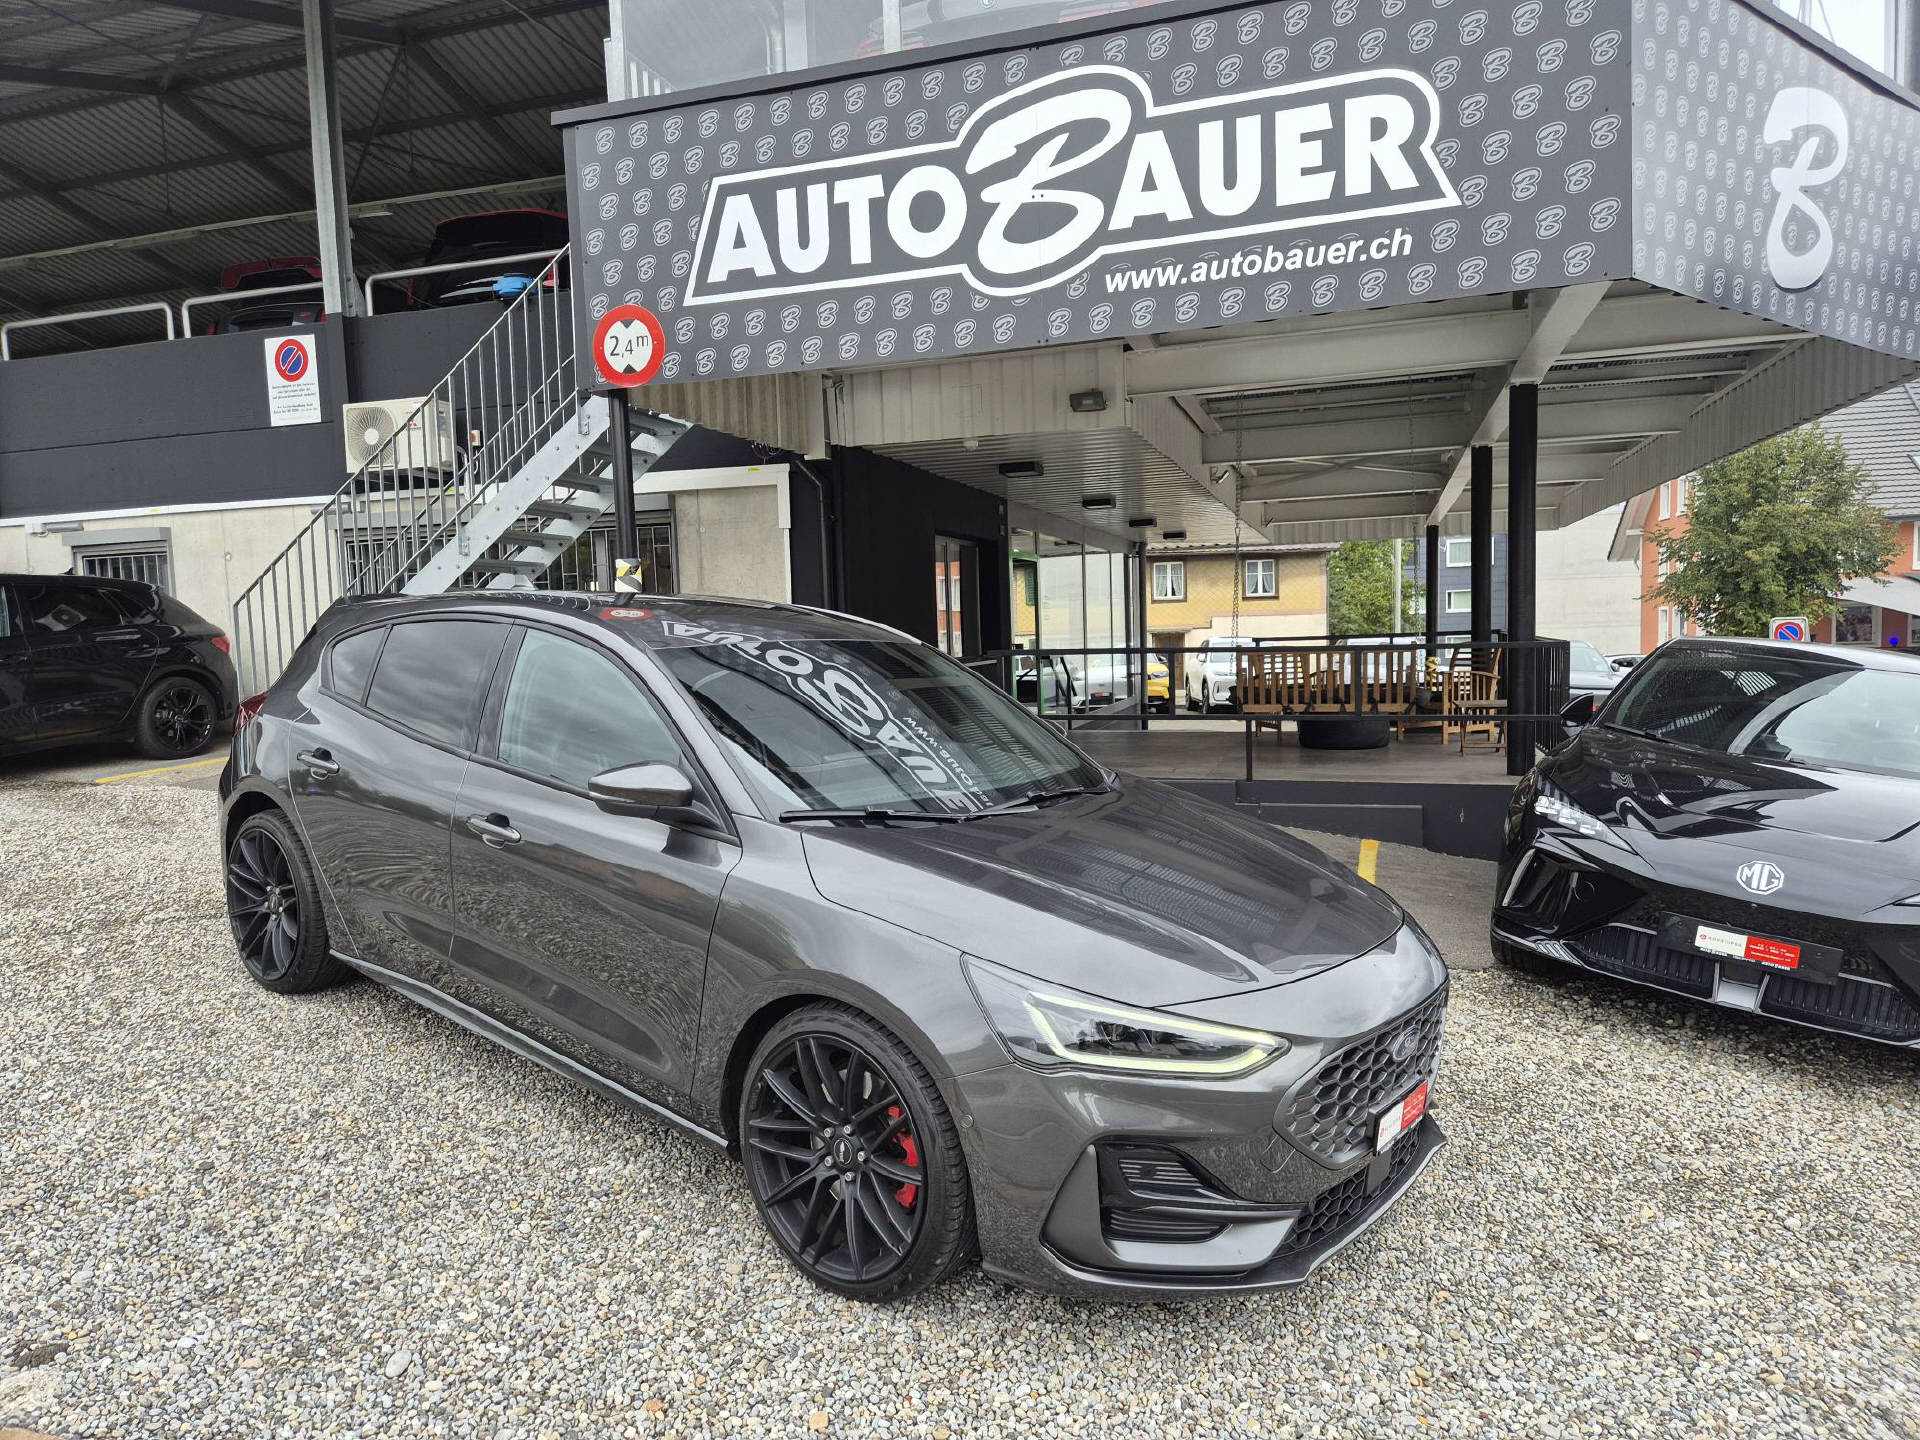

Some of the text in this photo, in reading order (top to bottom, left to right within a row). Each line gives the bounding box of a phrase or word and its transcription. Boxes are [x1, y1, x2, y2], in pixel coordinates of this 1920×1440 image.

[707, 165, 967, 283] AUTO
[1105, 228, 1413, 293] www.autobauer.ch
[1740, 862, 1781, 892] MG
